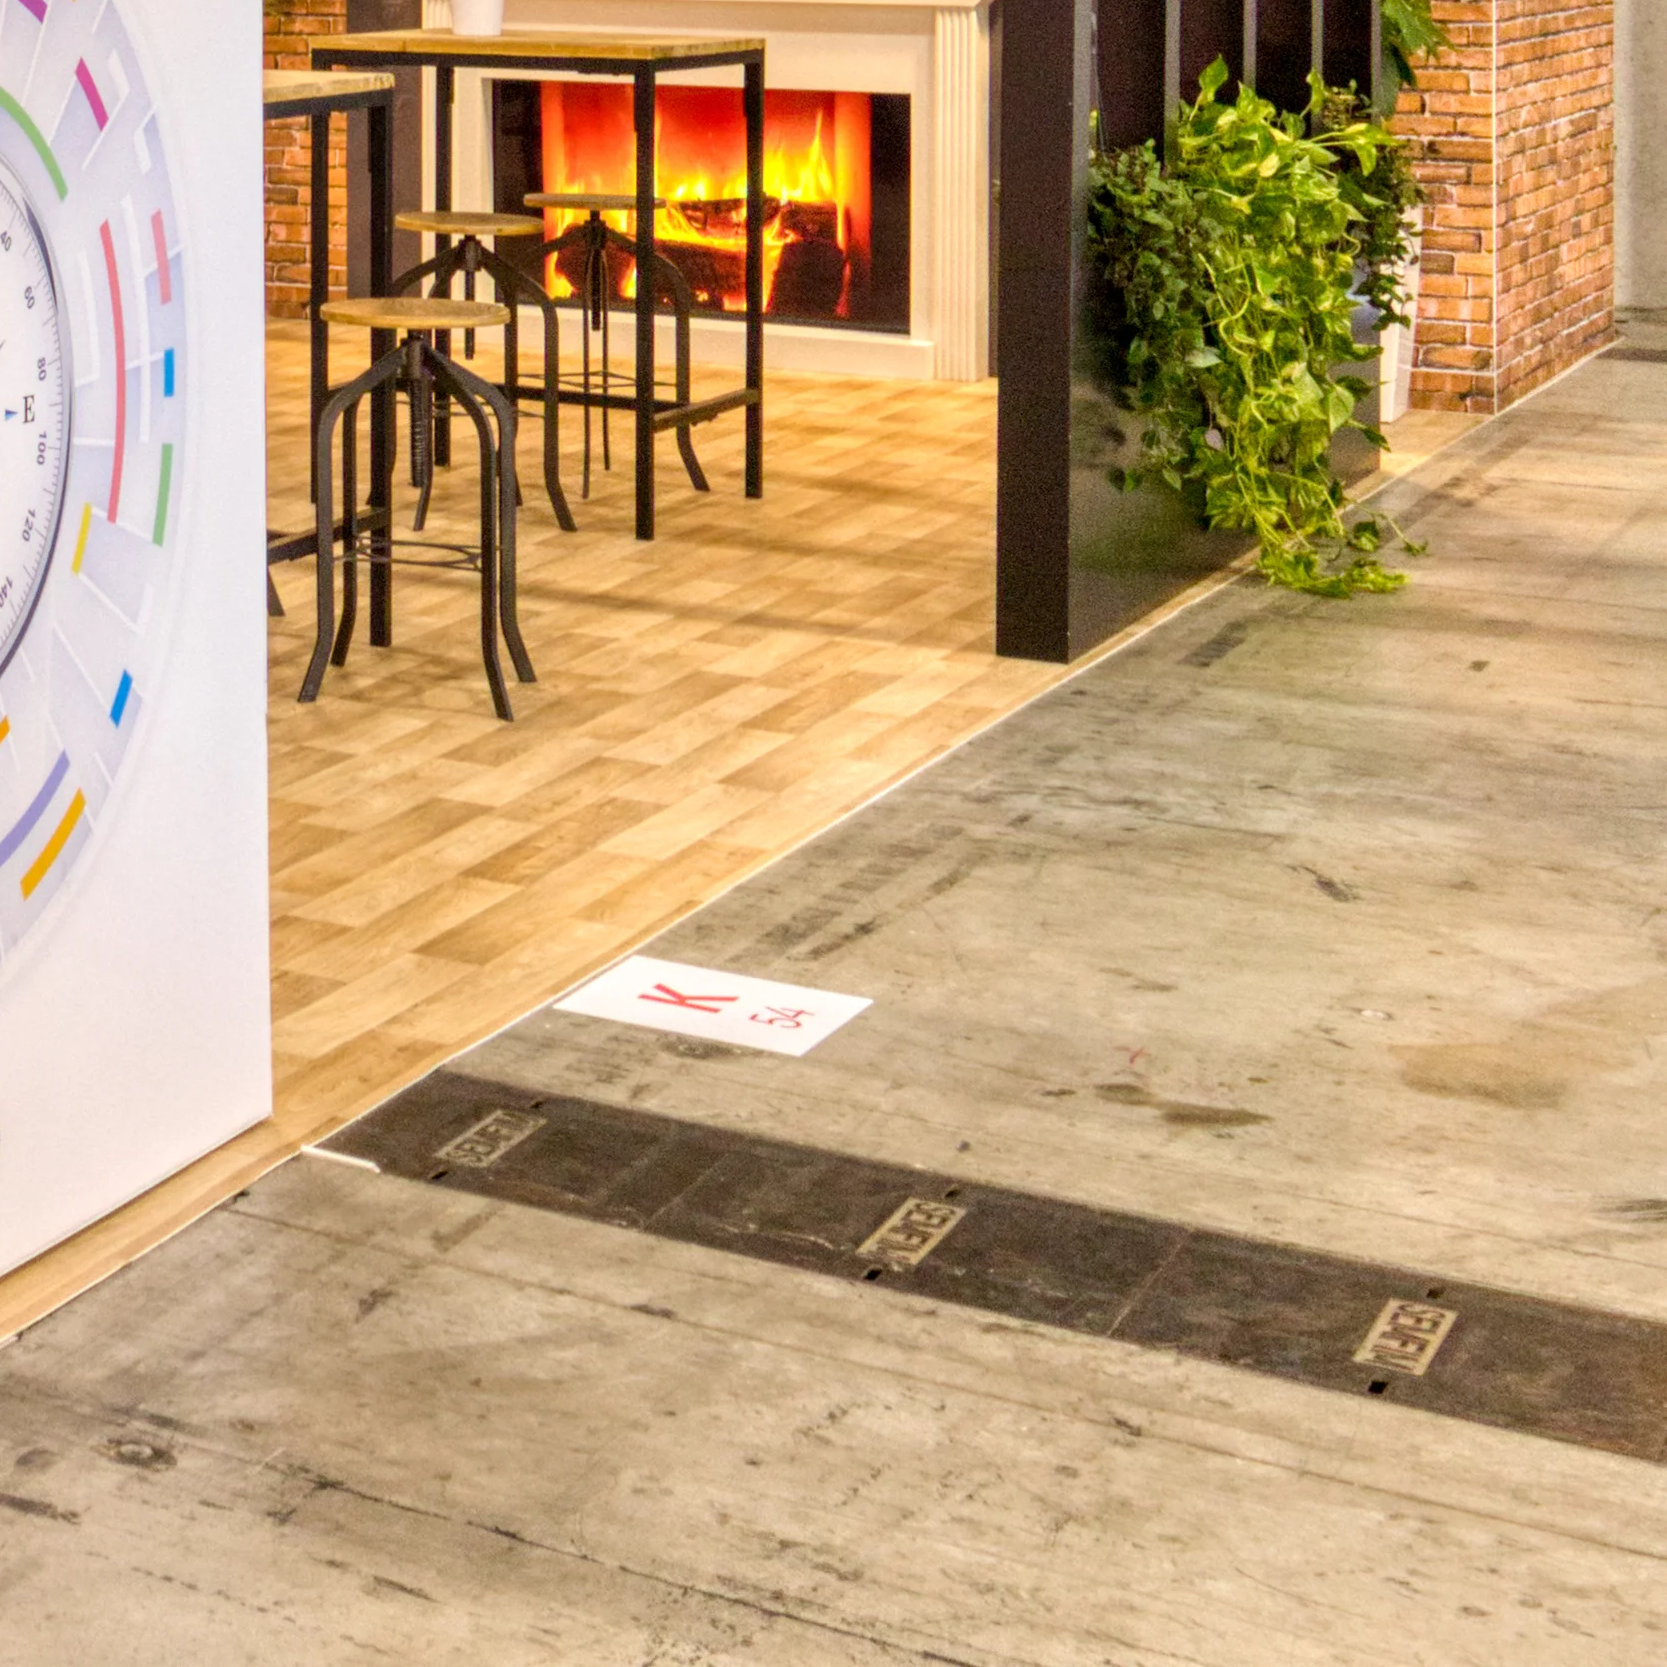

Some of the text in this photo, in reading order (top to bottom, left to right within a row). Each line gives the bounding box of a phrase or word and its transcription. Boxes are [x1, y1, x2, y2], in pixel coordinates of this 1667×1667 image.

[0, 231, 12, 252] 40
[24, 286, 35, 309] 60
[37, 357, 47, 381] 80
[23, 395, 35, 423] E
[37, 430, 47, 465] 100
[22, 508, 36, 542] 120
[637, 983, 740, 1014] K
